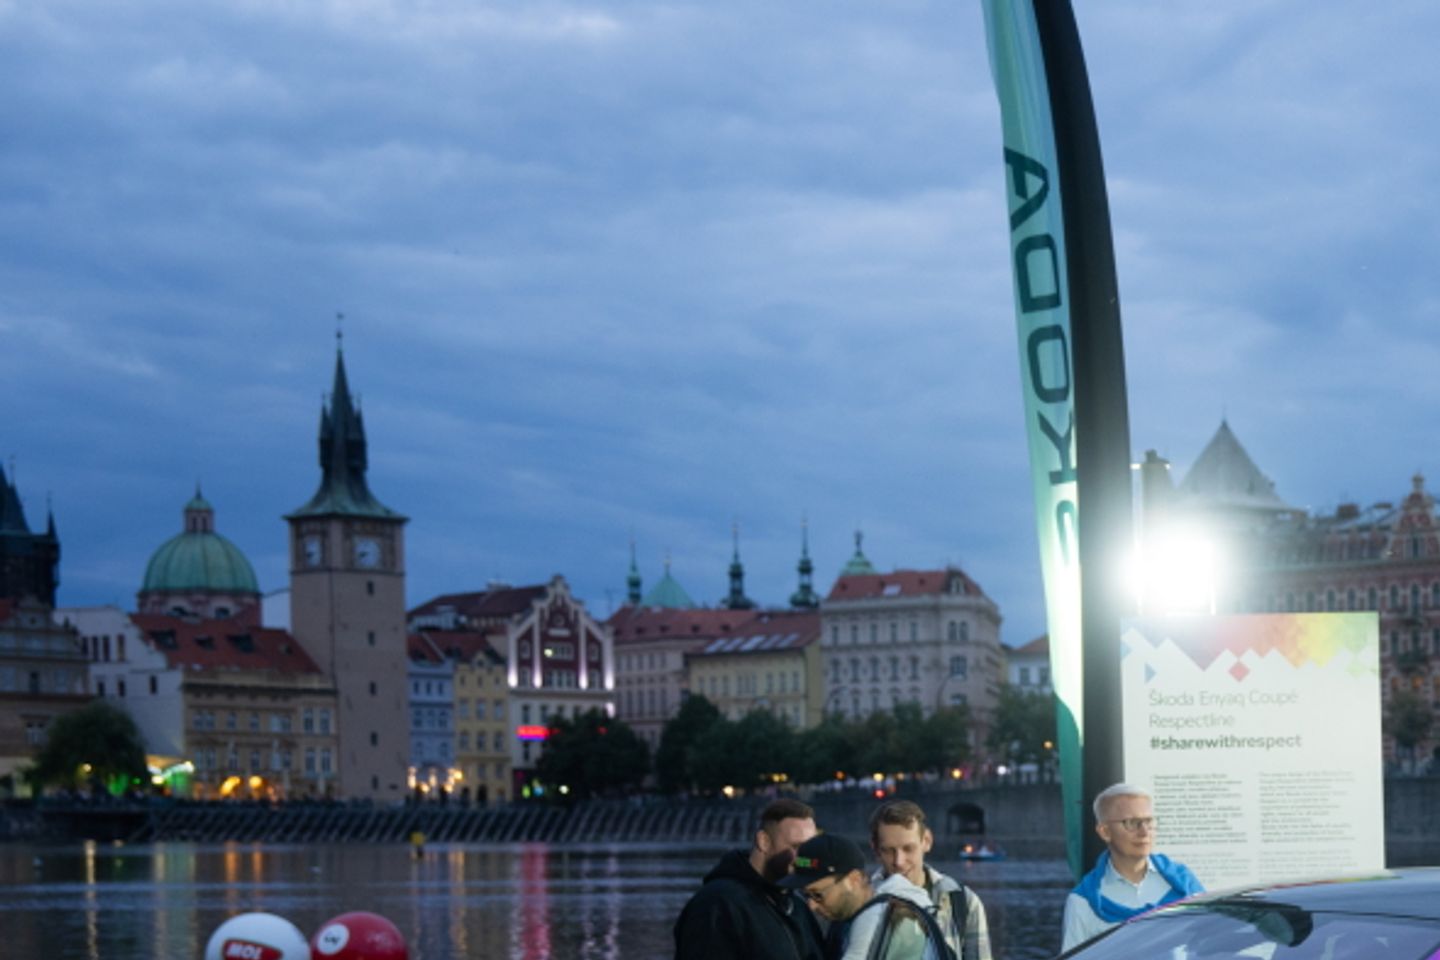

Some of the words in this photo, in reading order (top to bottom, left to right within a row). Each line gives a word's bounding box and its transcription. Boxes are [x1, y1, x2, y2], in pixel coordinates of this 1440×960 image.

[1149, 688, 1194, 706] Škoda
[1200, 690, 1245, 707] Enyaq
[1149, 713, 1234, 730] Respectline
[1150, 734, 1302, 751] #sharewithrespect
